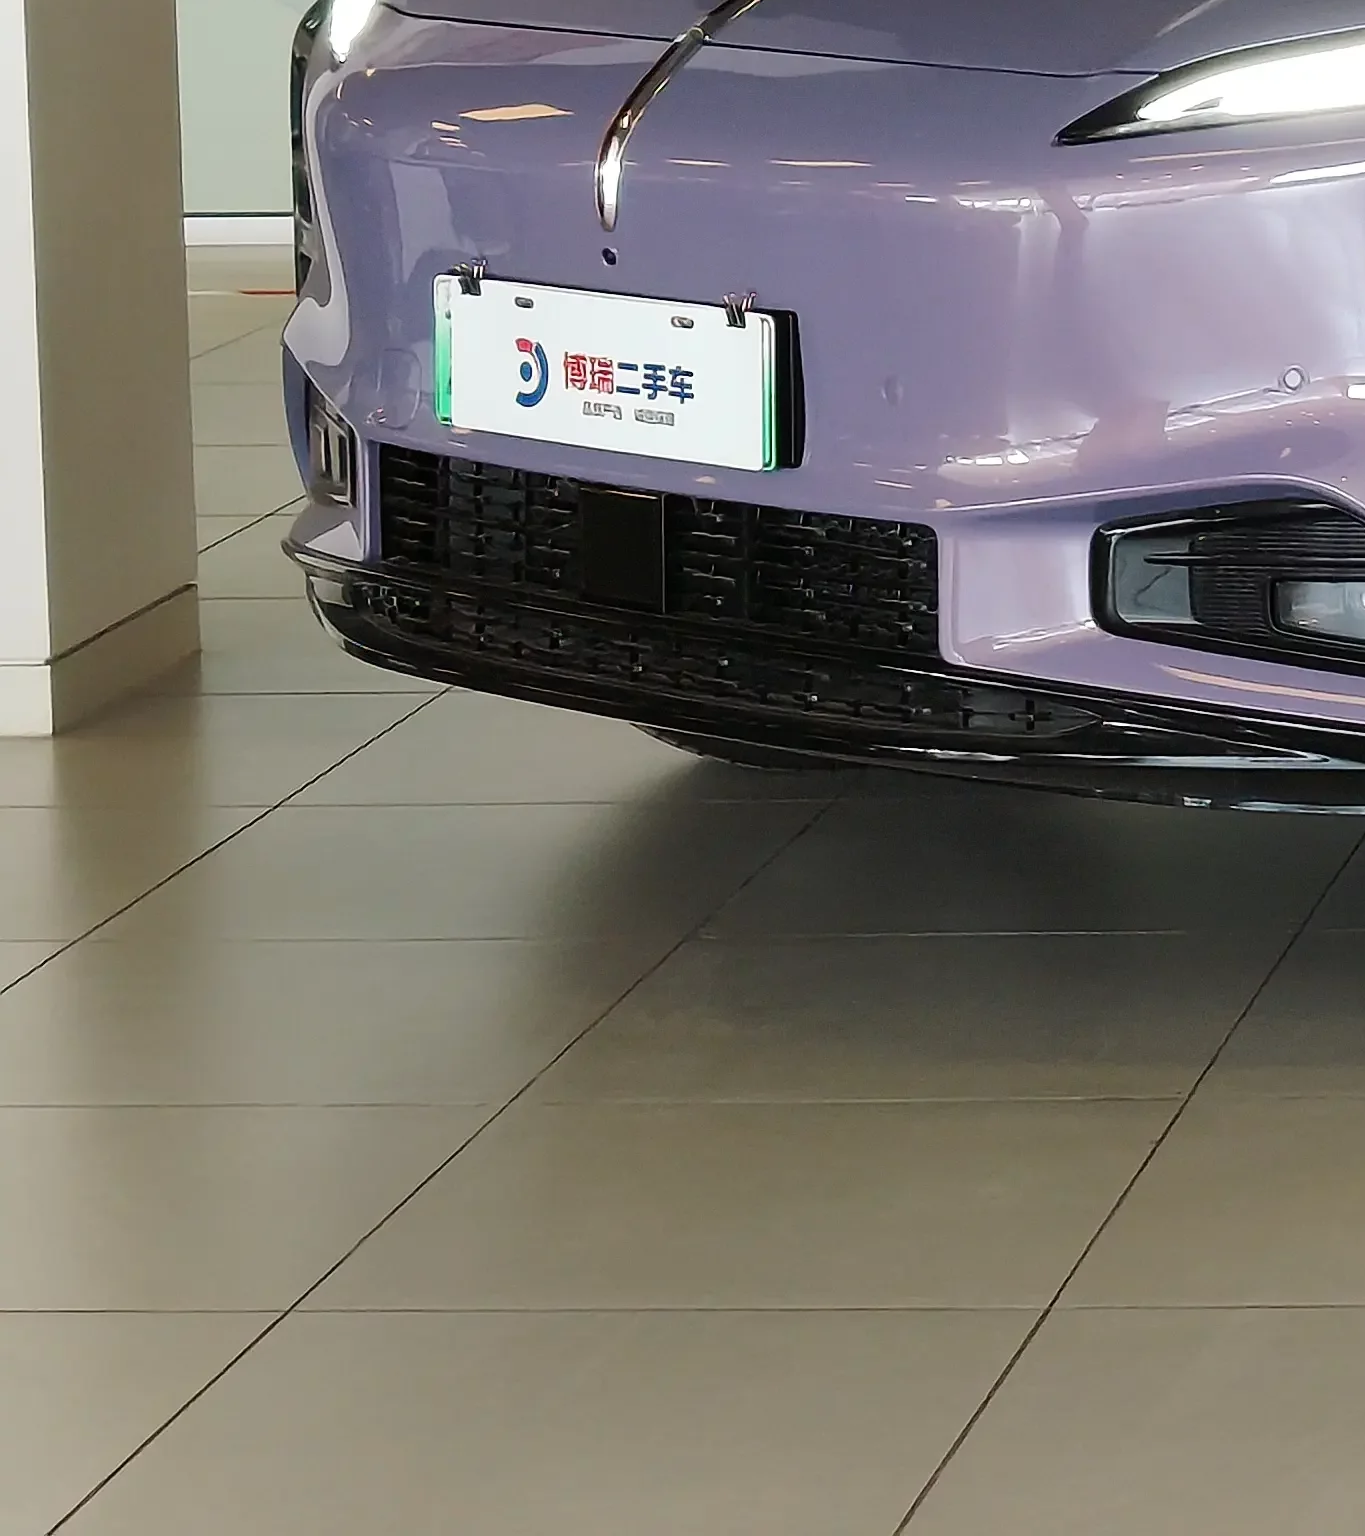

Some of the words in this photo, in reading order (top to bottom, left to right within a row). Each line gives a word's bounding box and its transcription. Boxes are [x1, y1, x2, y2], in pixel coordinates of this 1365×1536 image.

[563, 351, 695, 404] 博瑞二手车
